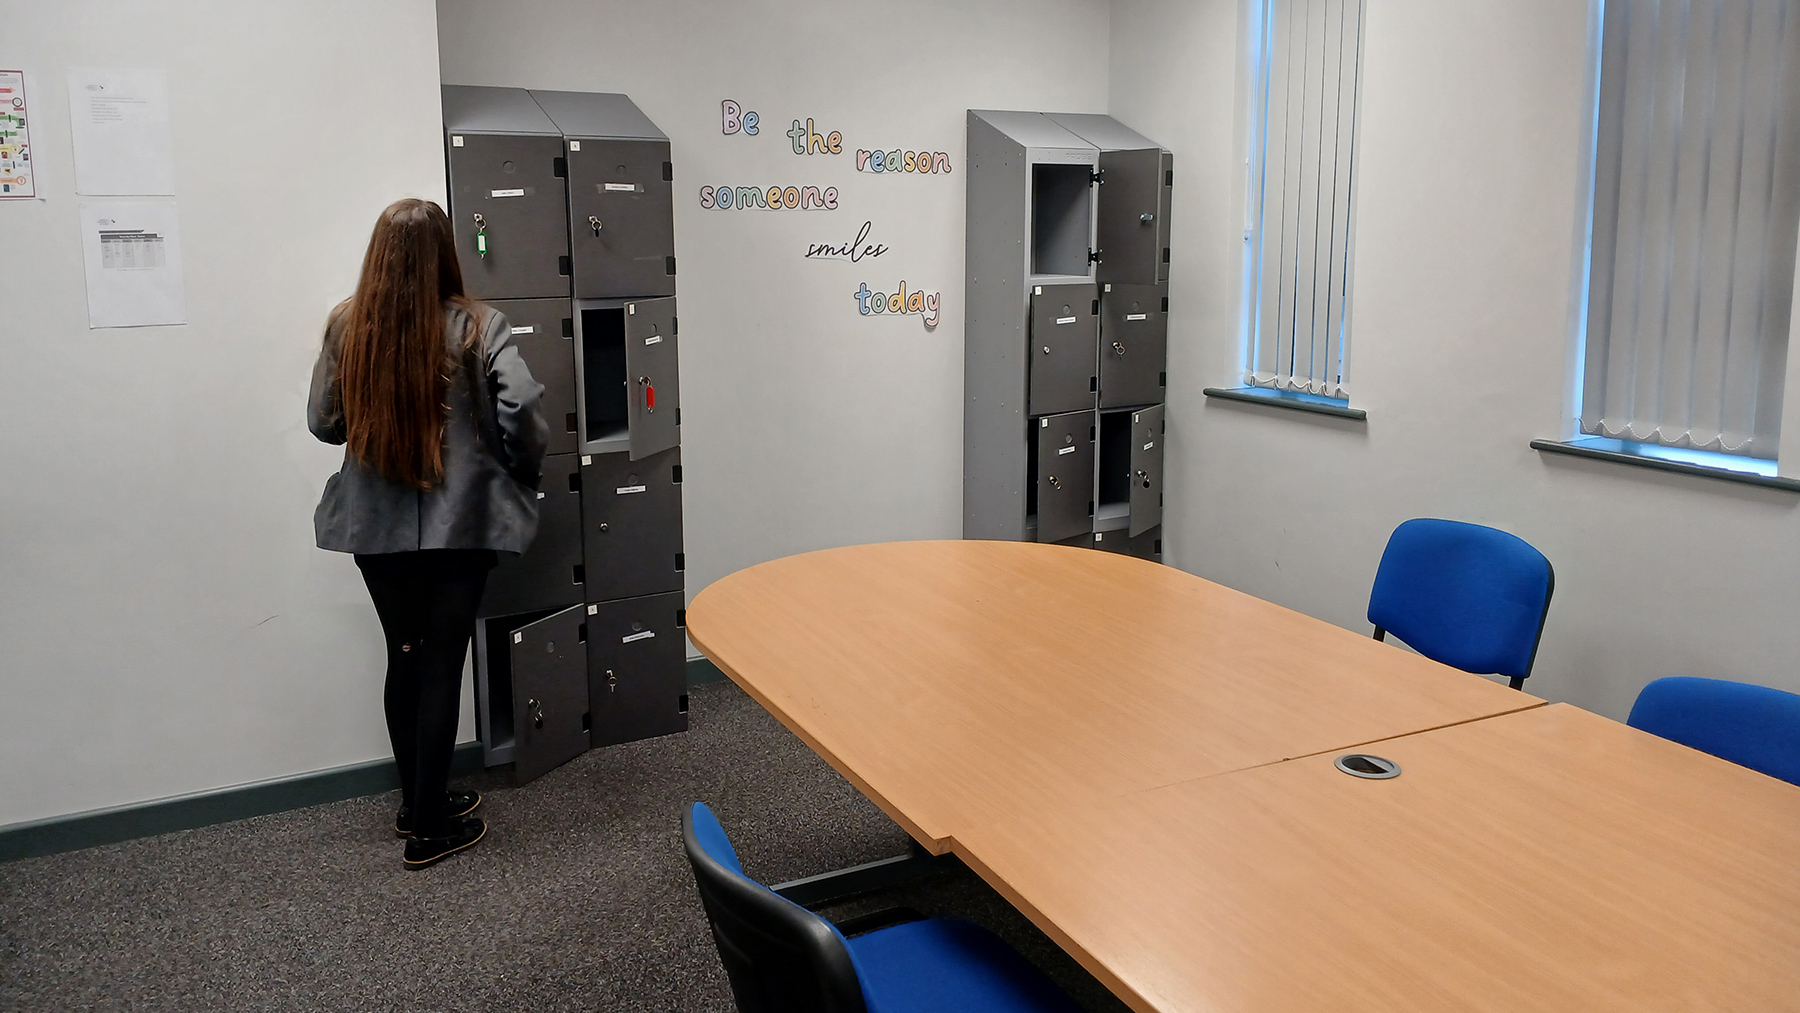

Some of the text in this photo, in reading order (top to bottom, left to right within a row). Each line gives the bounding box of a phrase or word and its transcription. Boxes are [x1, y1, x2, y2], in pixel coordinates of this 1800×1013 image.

[722, 99, 952, 174] Be the reason
[700, 185, 839, 210] someone
[805, 221, 889, 262] smiles
[853, 280, 941, 327] today
